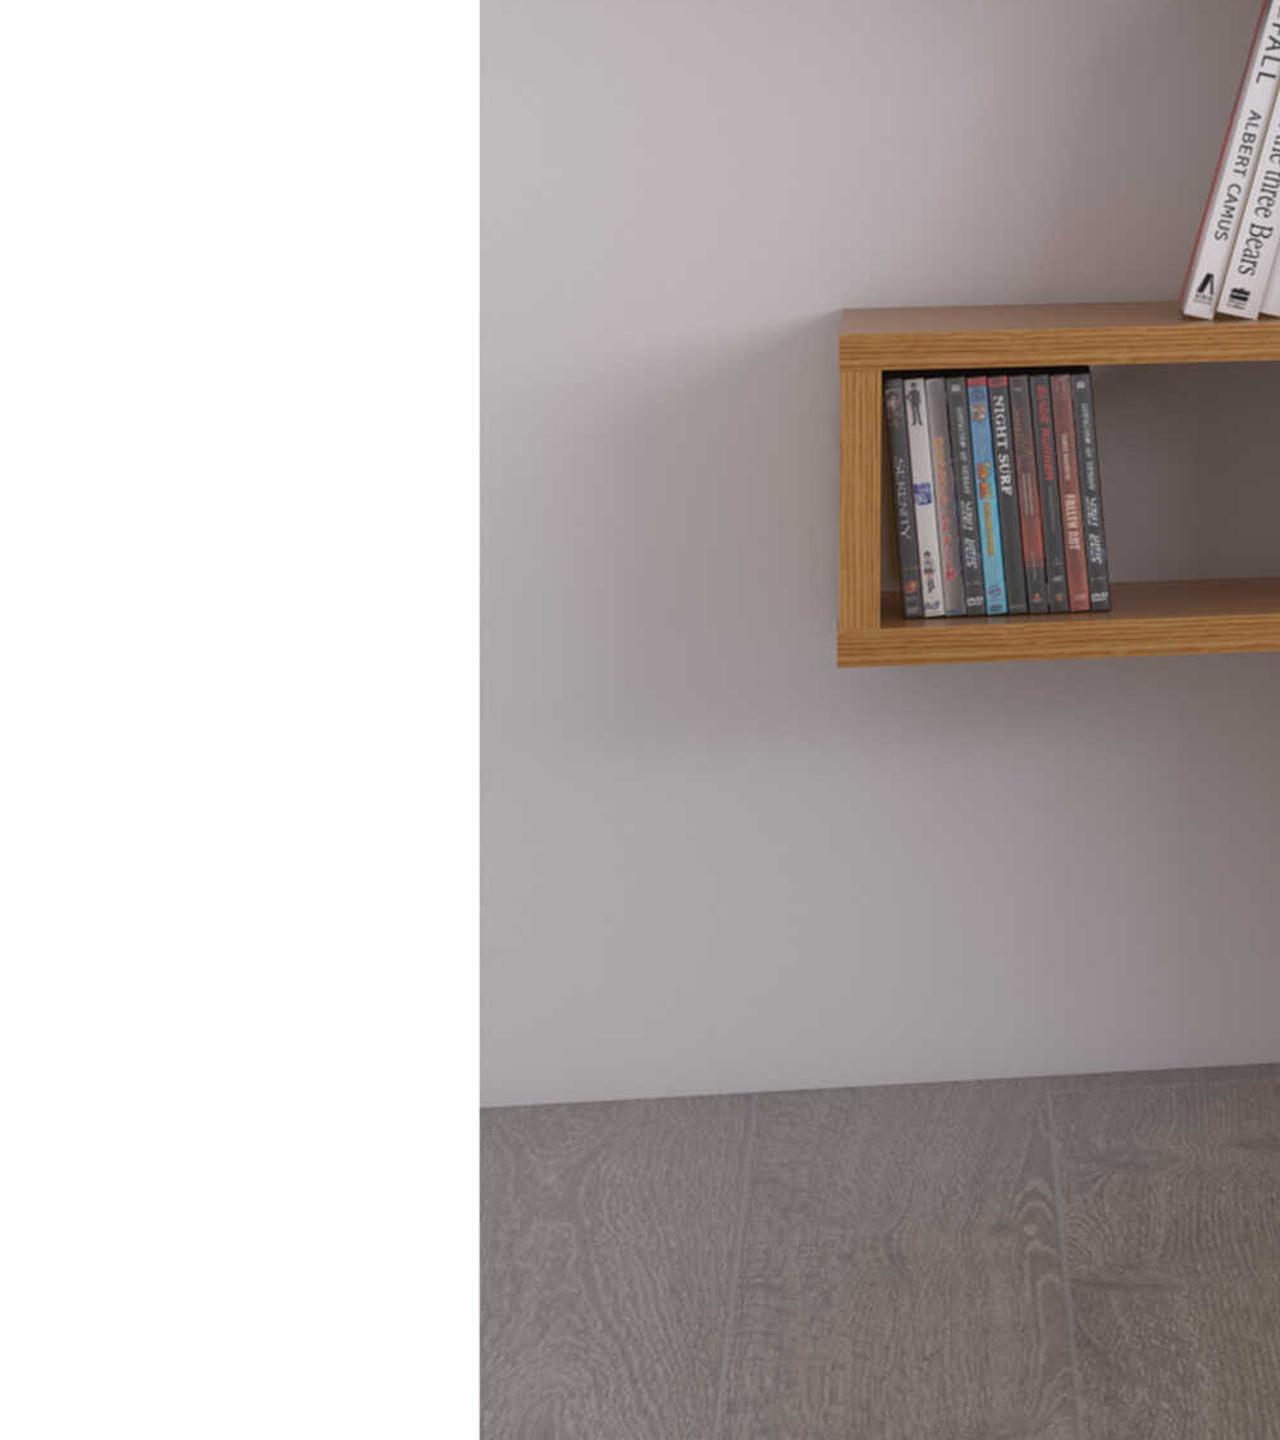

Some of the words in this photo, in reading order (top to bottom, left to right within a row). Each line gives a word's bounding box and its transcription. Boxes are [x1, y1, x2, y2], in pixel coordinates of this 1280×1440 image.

[1231, 108, 1263, 177] ALBERT
[1213, 181, 1243, 243] CAMUS
[1236, 220, 1274, 279] Bears
[991, 395, 1008, 450] NIGHT
[997, 453, 1012, 496] SURF
